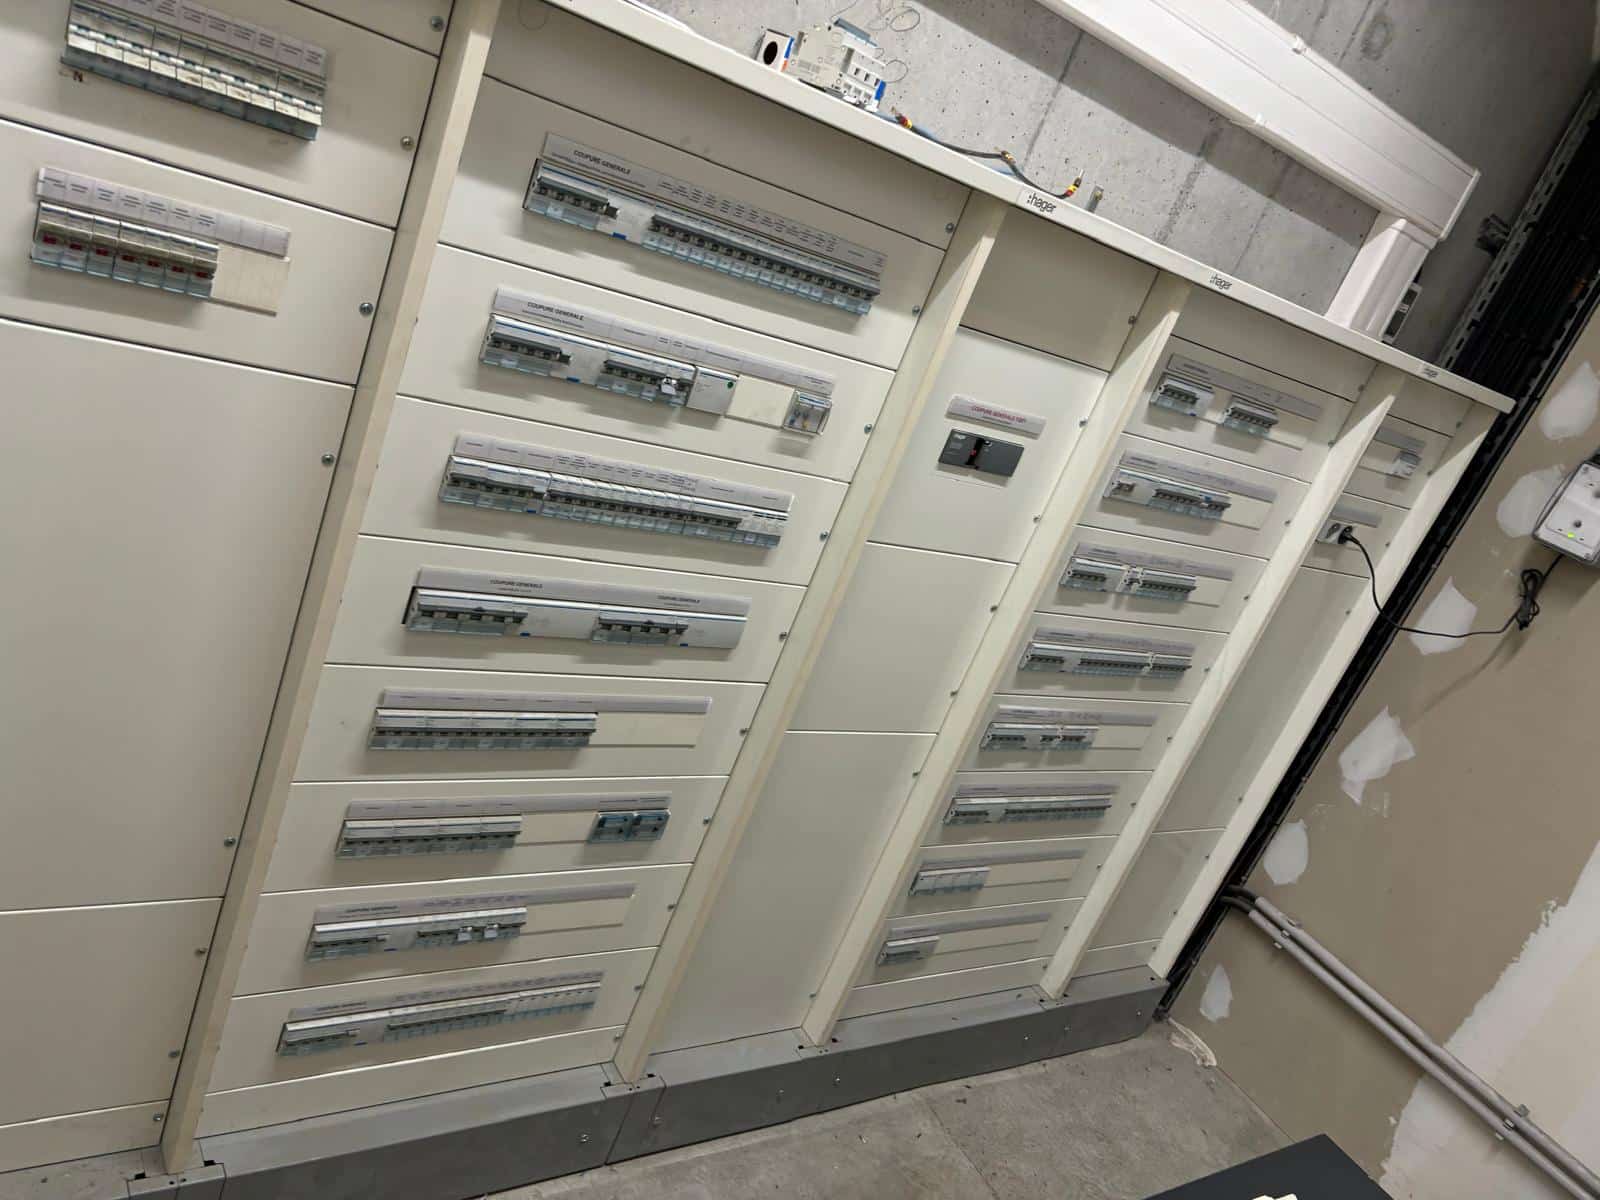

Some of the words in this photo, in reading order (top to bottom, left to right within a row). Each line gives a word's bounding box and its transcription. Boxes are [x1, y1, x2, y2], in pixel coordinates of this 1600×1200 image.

[573, 150, 601, 164] COUPURE
[527, 301, 554, 312] COUPURE
[554, 308, 585, 320] GENERALE
